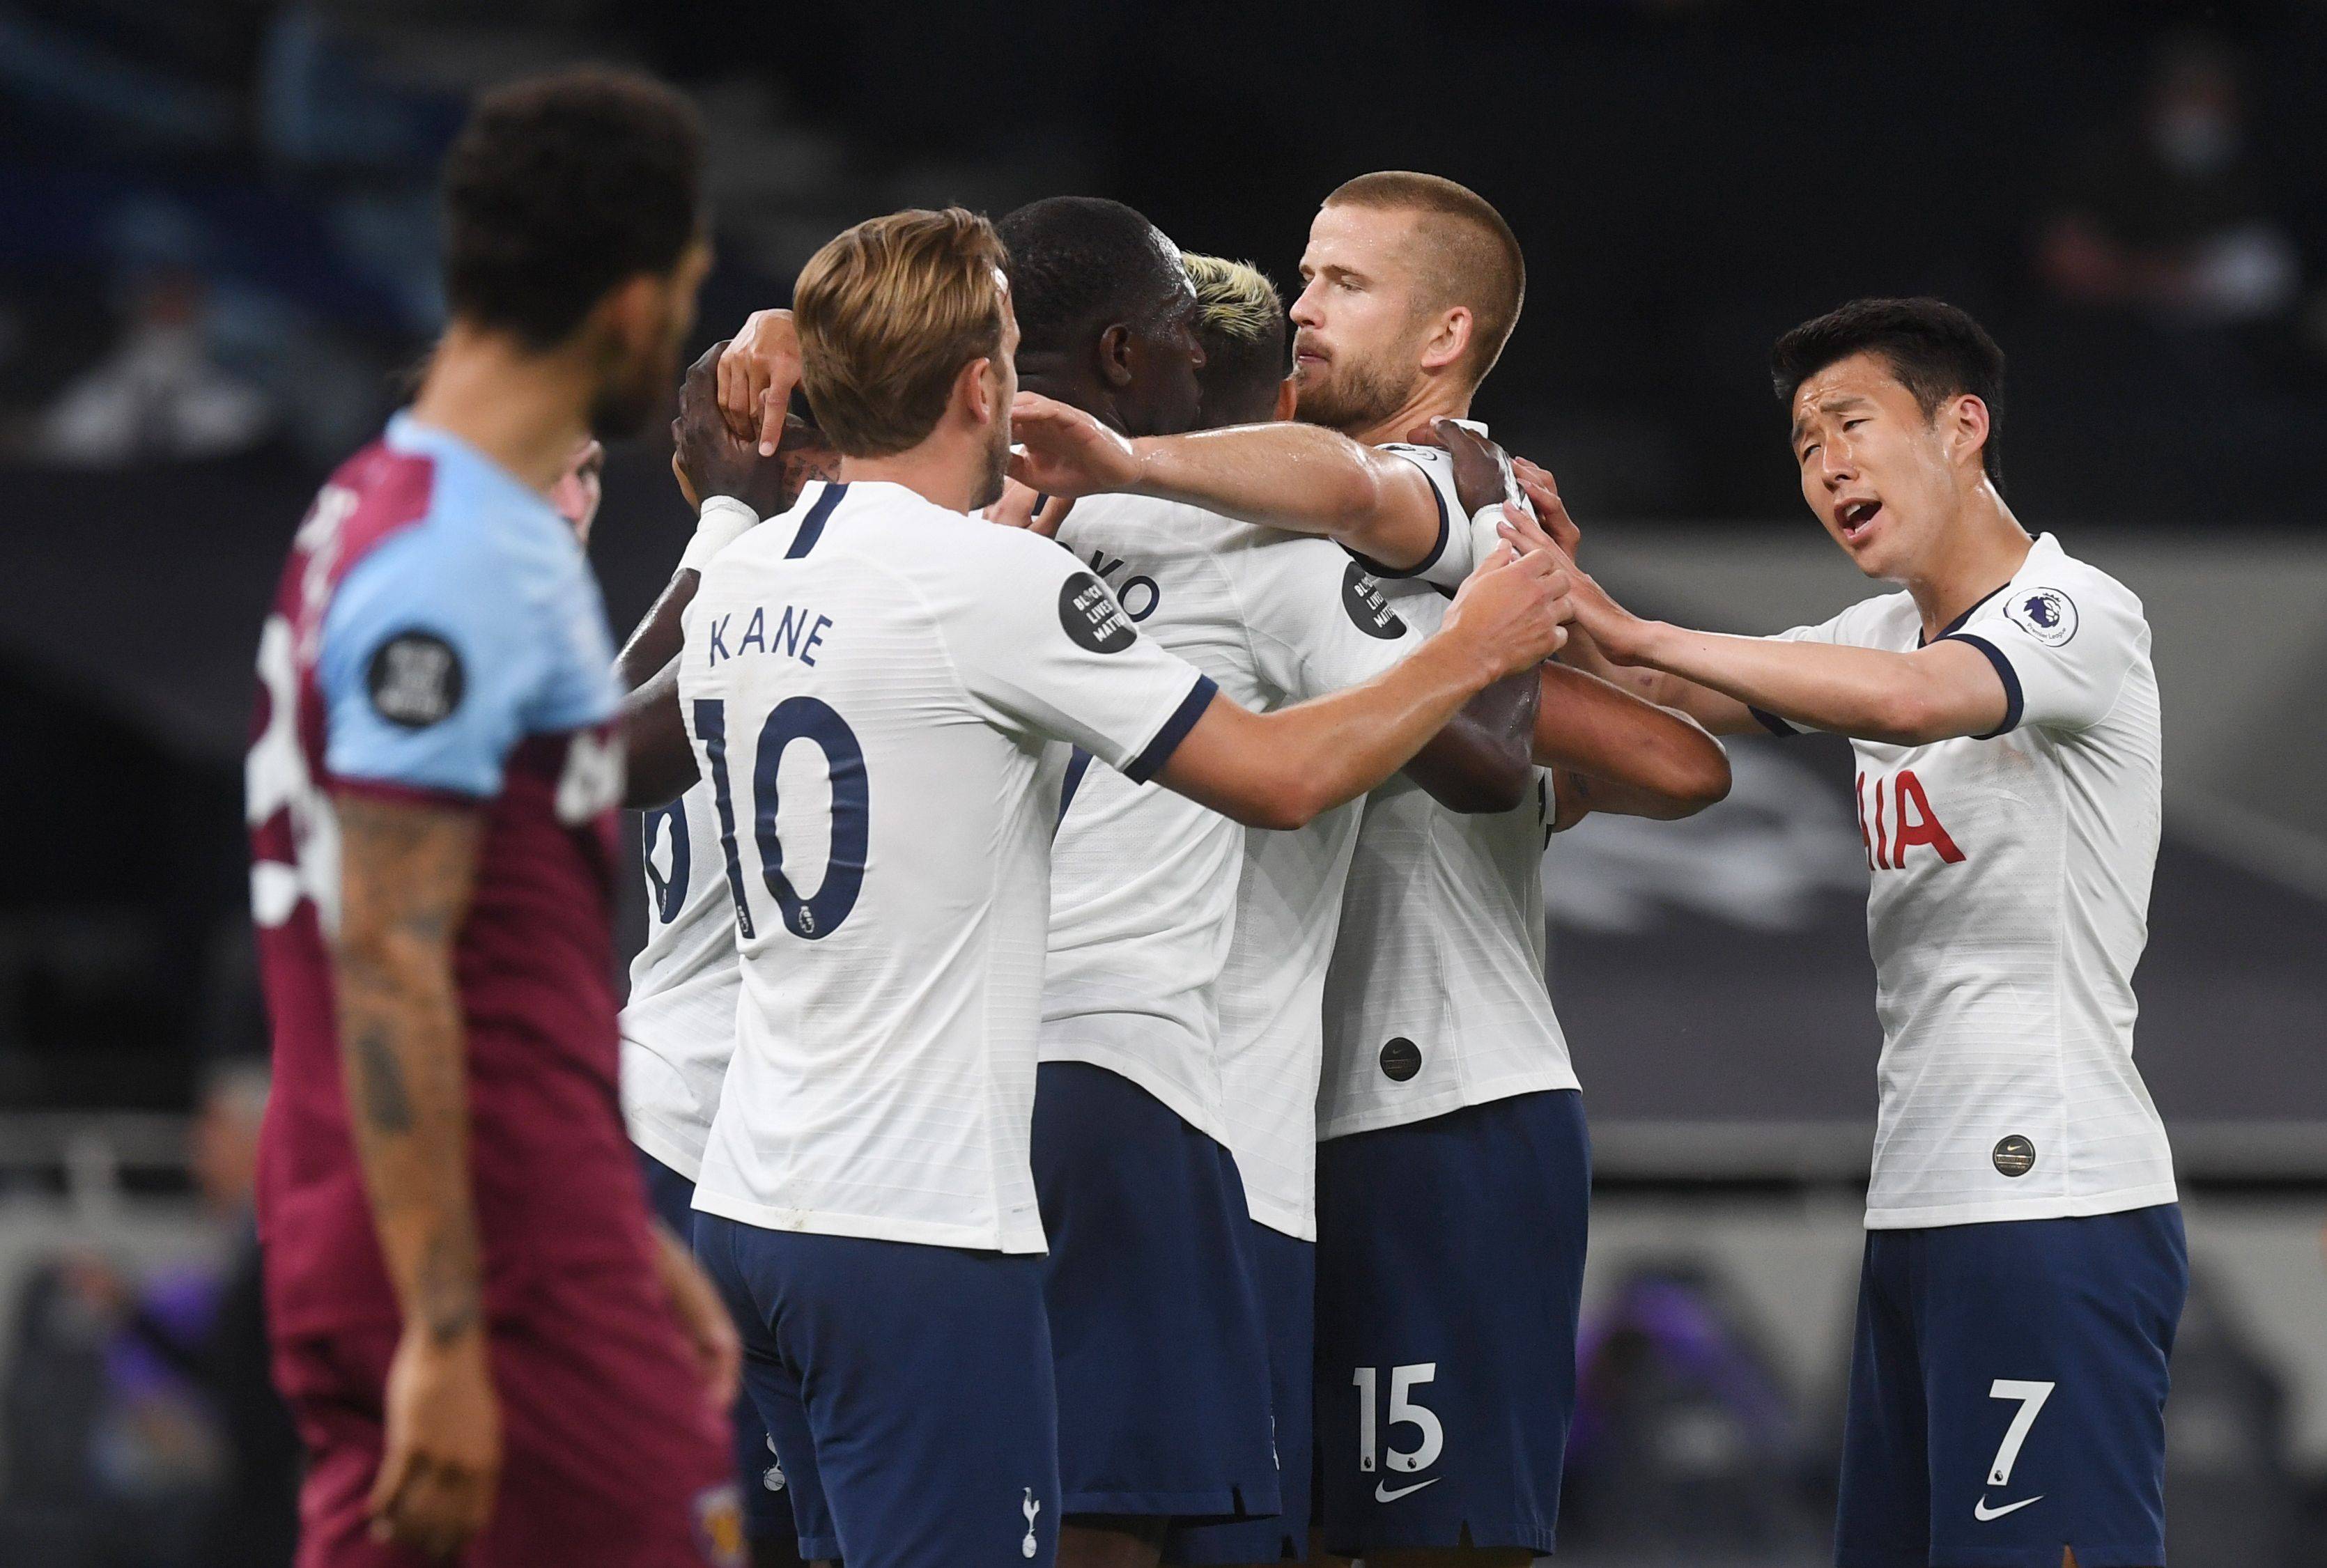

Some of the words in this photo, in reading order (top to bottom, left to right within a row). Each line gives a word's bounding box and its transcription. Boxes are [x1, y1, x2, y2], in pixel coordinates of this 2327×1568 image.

[709, 605, 833, 668] KANE
[1085, 599, 1113, 624] LIVES
[693, 696, 869, 940] 10
[1352, 1363, 1444, 1473] 15
[1986, 1379, 2055, 1486] 7
